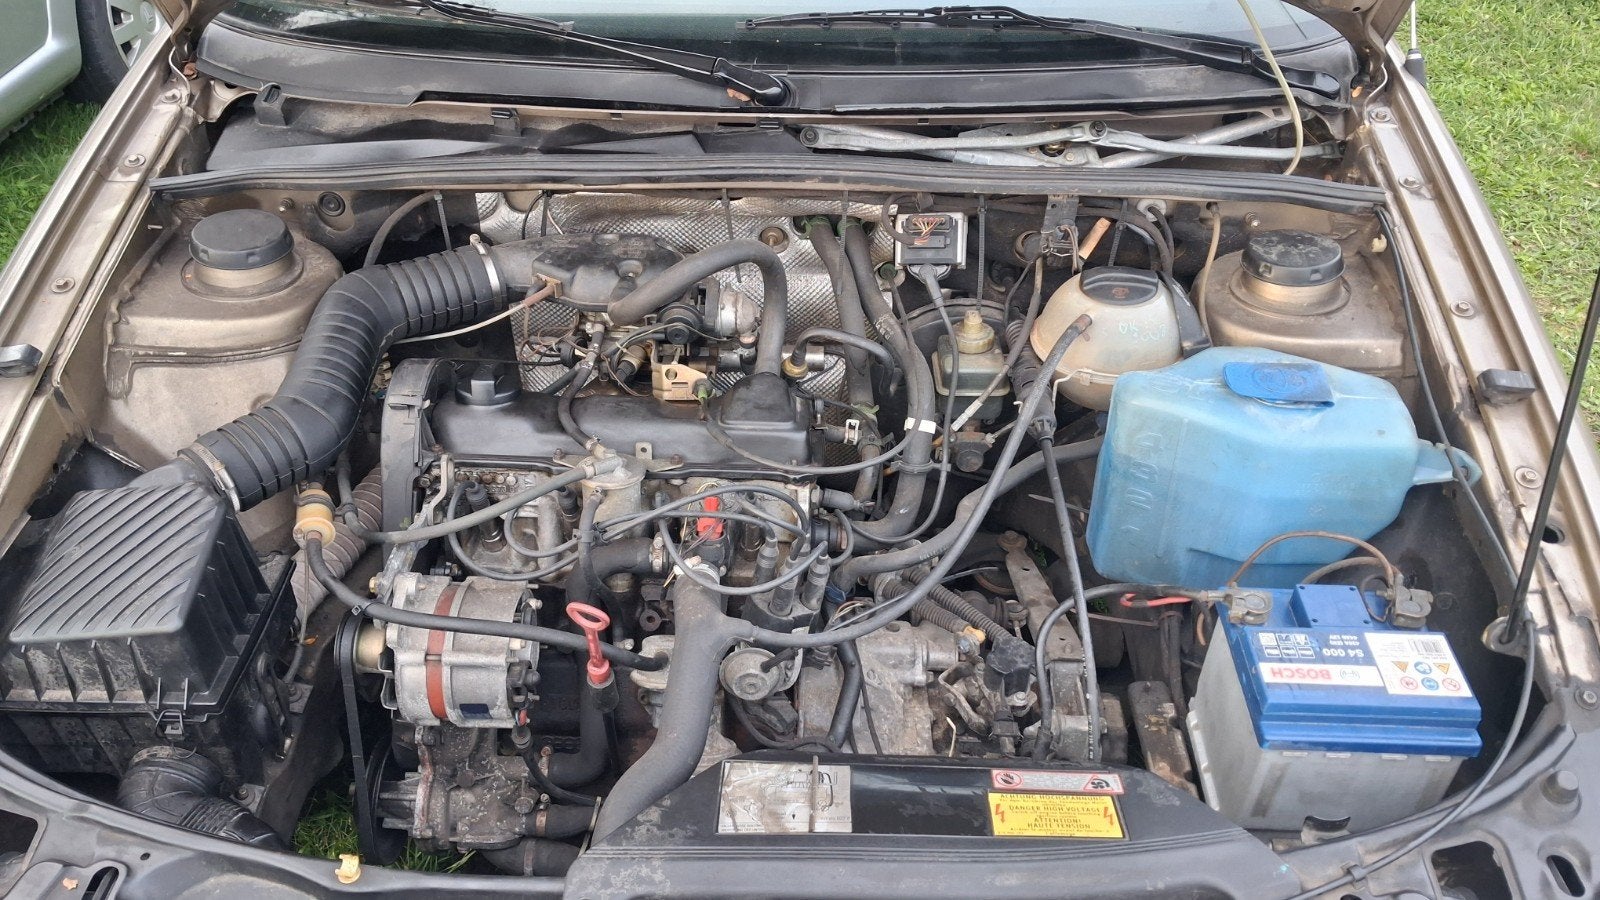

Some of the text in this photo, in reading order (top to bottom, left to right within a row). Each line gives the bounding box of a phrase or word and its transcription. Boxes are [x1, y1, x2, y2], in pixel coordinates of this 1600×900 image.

[1322, 648, 1346, 657] 000
[1348, 648, 1364, 658] S4
[1270, 667, 1332, 679] BOSCH
